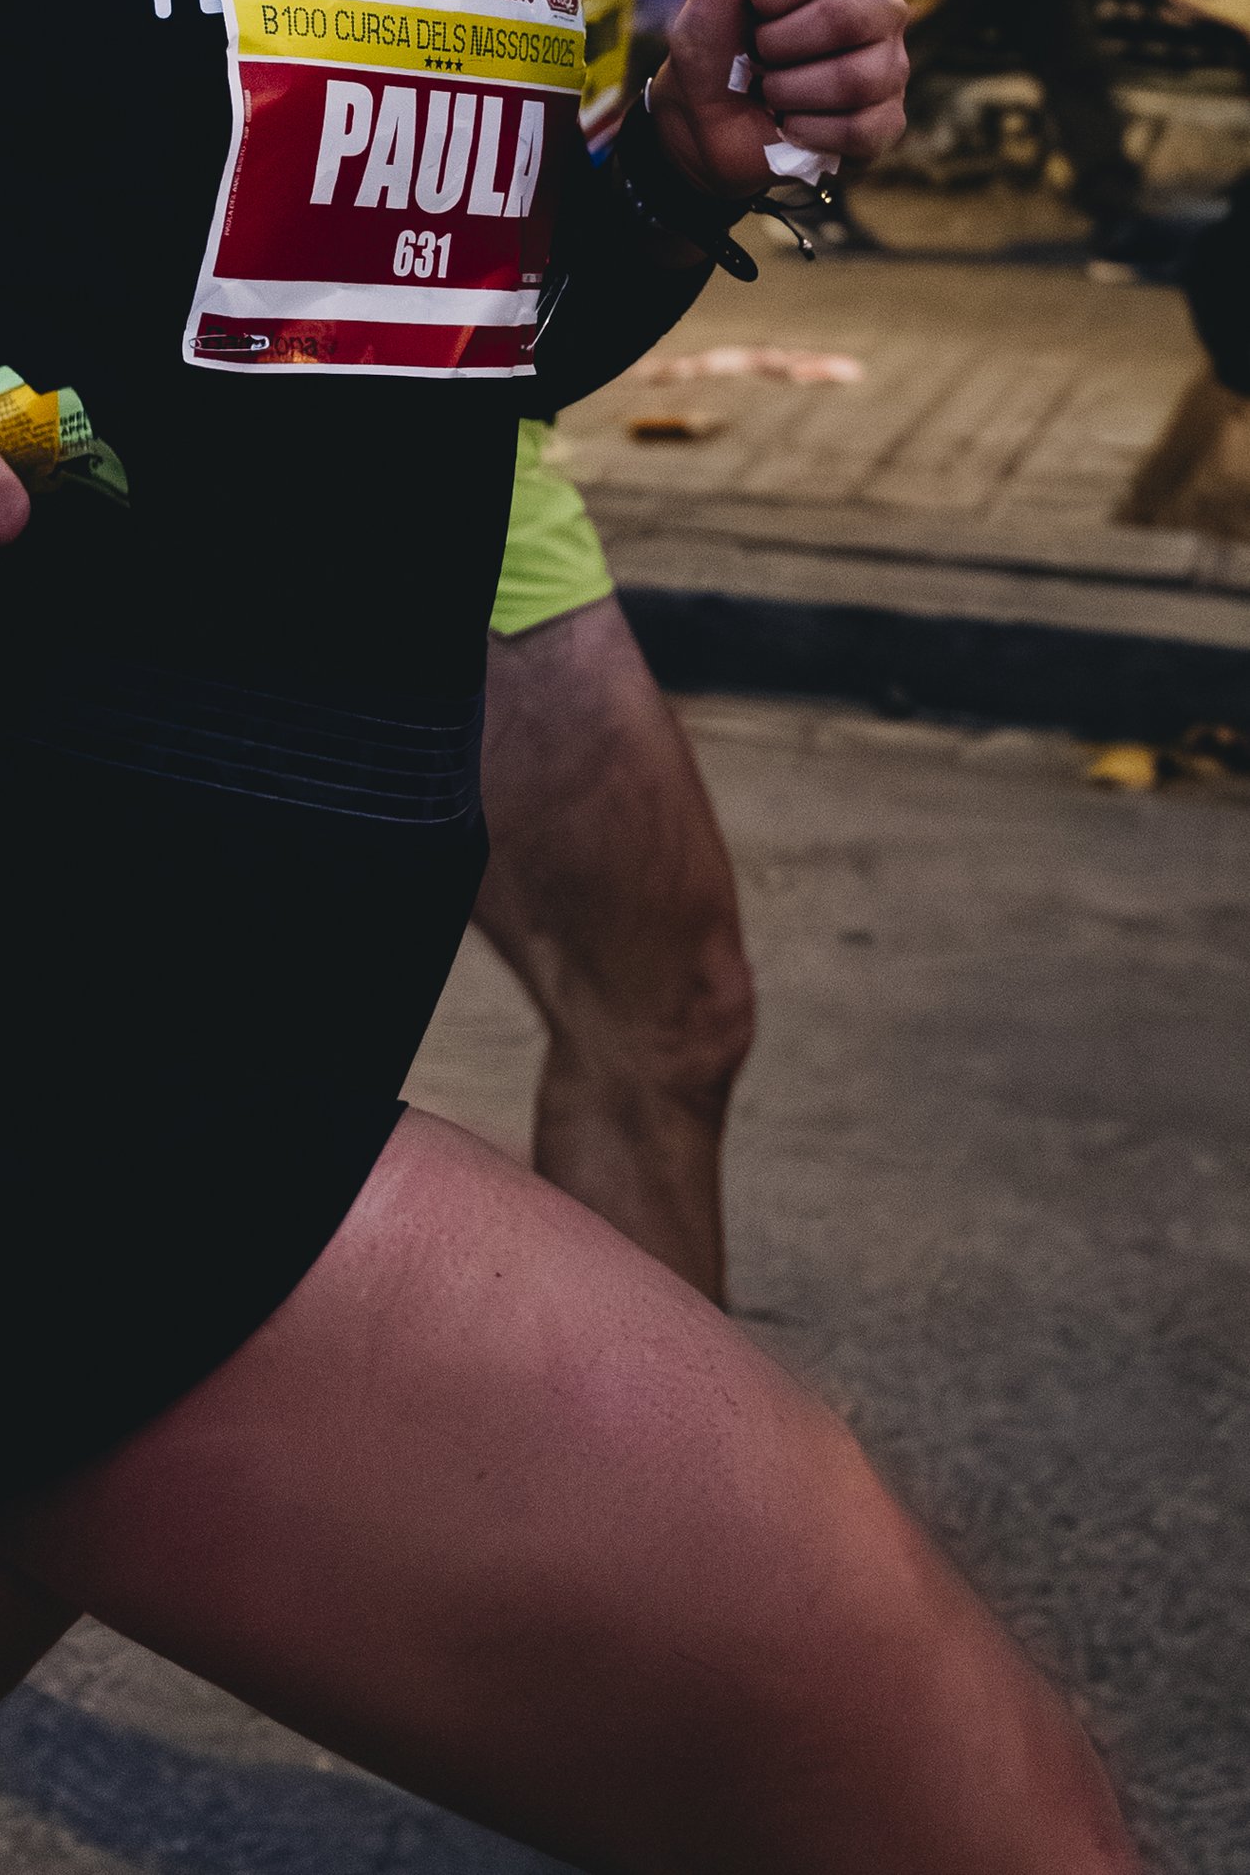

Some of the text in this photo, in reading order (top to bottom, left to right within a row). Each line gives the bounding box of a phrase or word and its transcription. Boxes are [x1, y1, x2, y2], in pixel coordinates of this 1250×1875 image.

[261, 5, 575, 68] B100 CURSA DELS NASSOS 2025
[310, 79, 545, 218] PAULA
[393, 229, 452, 278] 631
